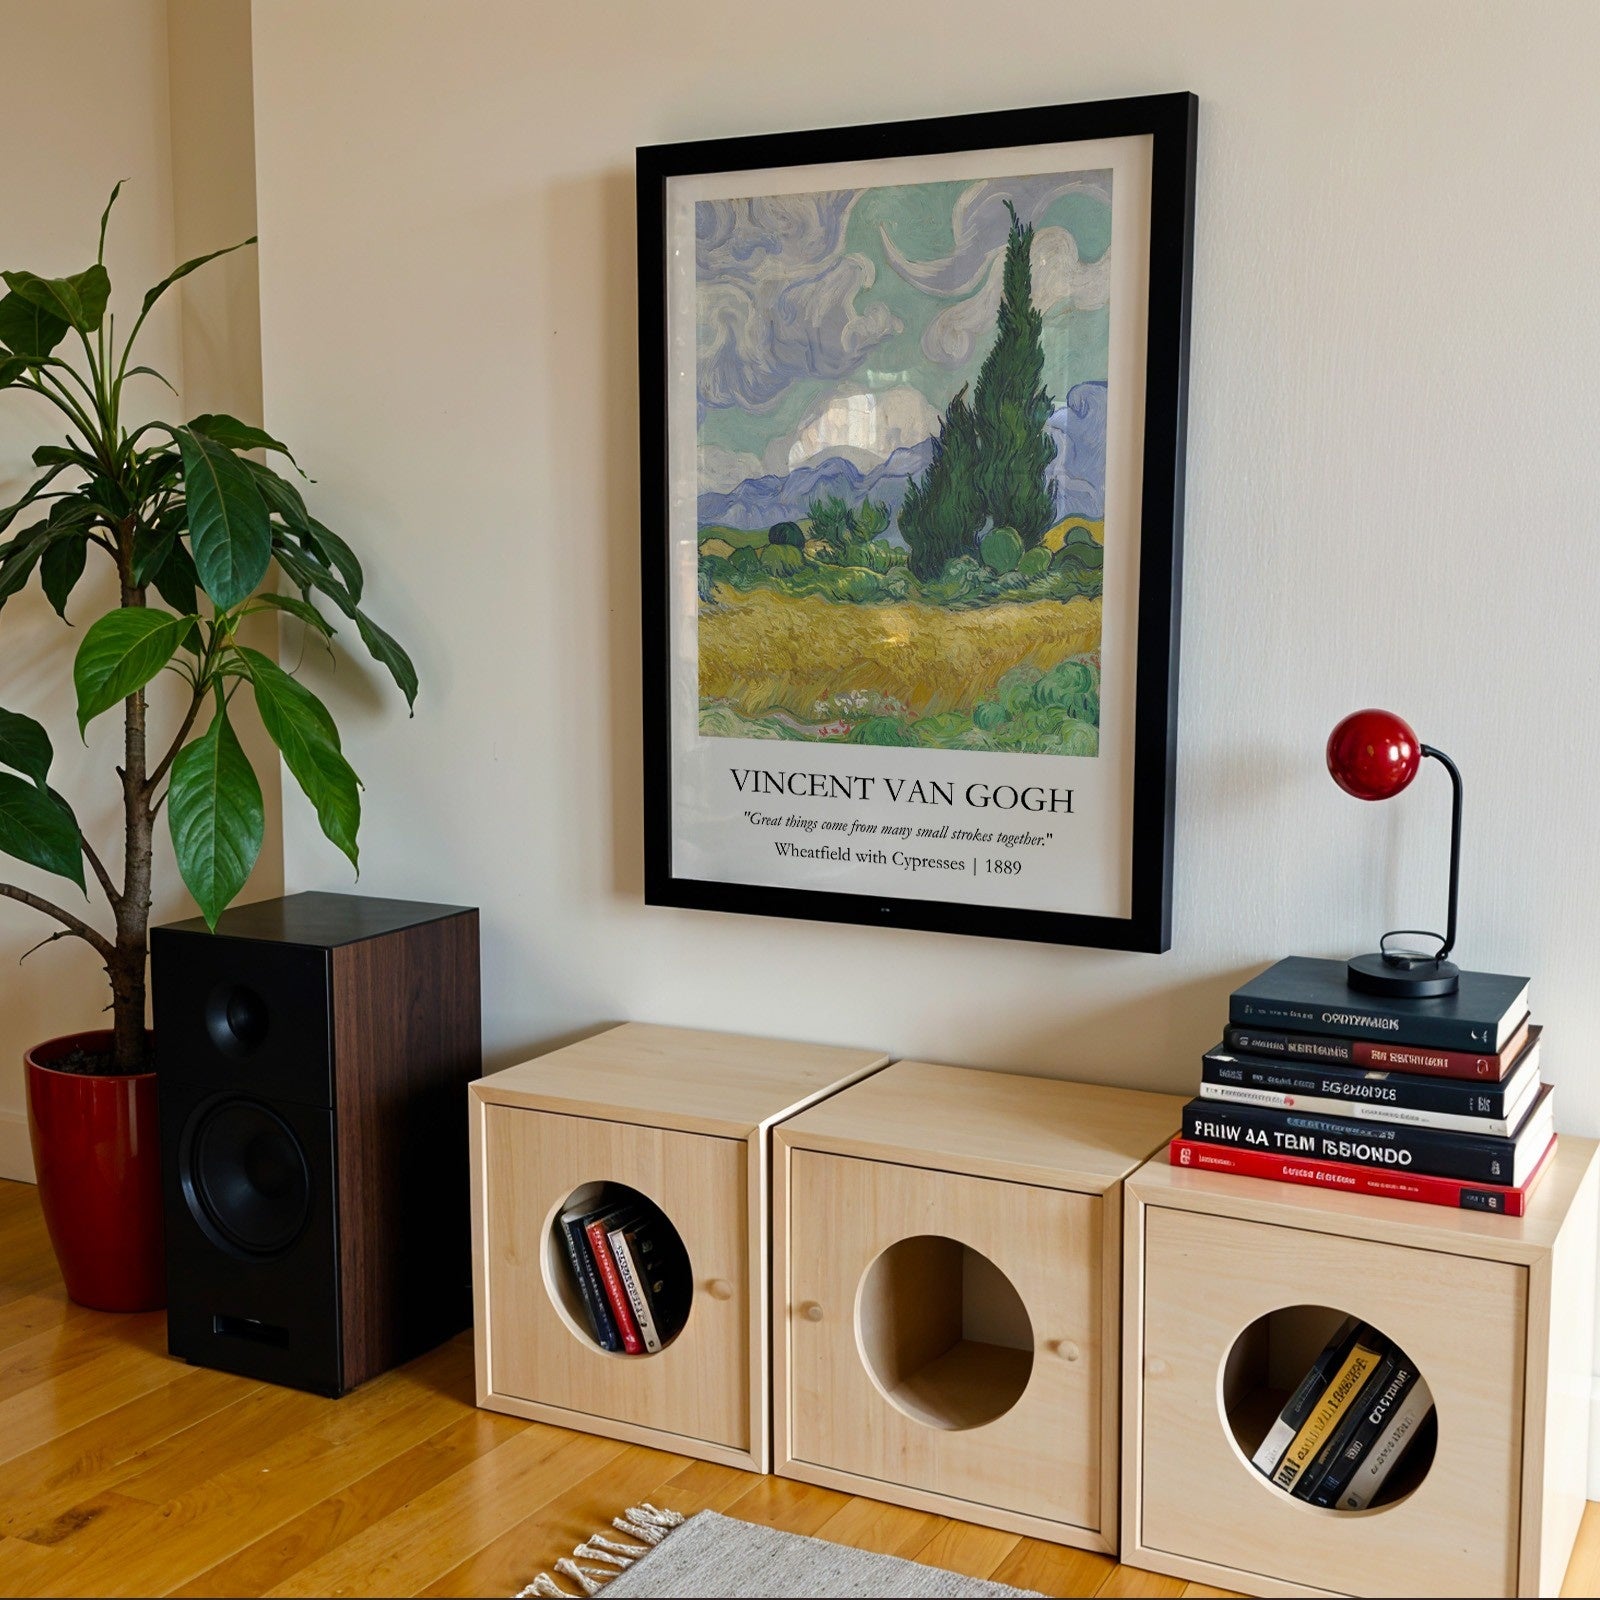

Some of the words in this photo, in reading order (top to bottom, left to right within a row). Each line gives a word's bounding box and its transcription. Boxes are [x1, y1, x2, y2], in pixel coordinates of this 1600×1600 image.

[729, 767, 875, 801] VINCENT
[882, 777, 955, 807] VAN
[965, 783, 1075, 814] GOGH
[743, 810, 783, 827] "Great
[784, 814, 818, 834] things
[820, 820, 847, 833] come
[847, 818, 878, 837] from
[880, 824, 913, 840] many
[915, 826, 949, 840] small
[950, 827, 993, 844] strokes
[996, 830, 1053, 848] together."
[773, 841, 851, 863] Wheatfield
[854, 848, 888, 865] with
[891, 850, 966, 872] Cypresses
[985, 858, 1022, 876] 1889
